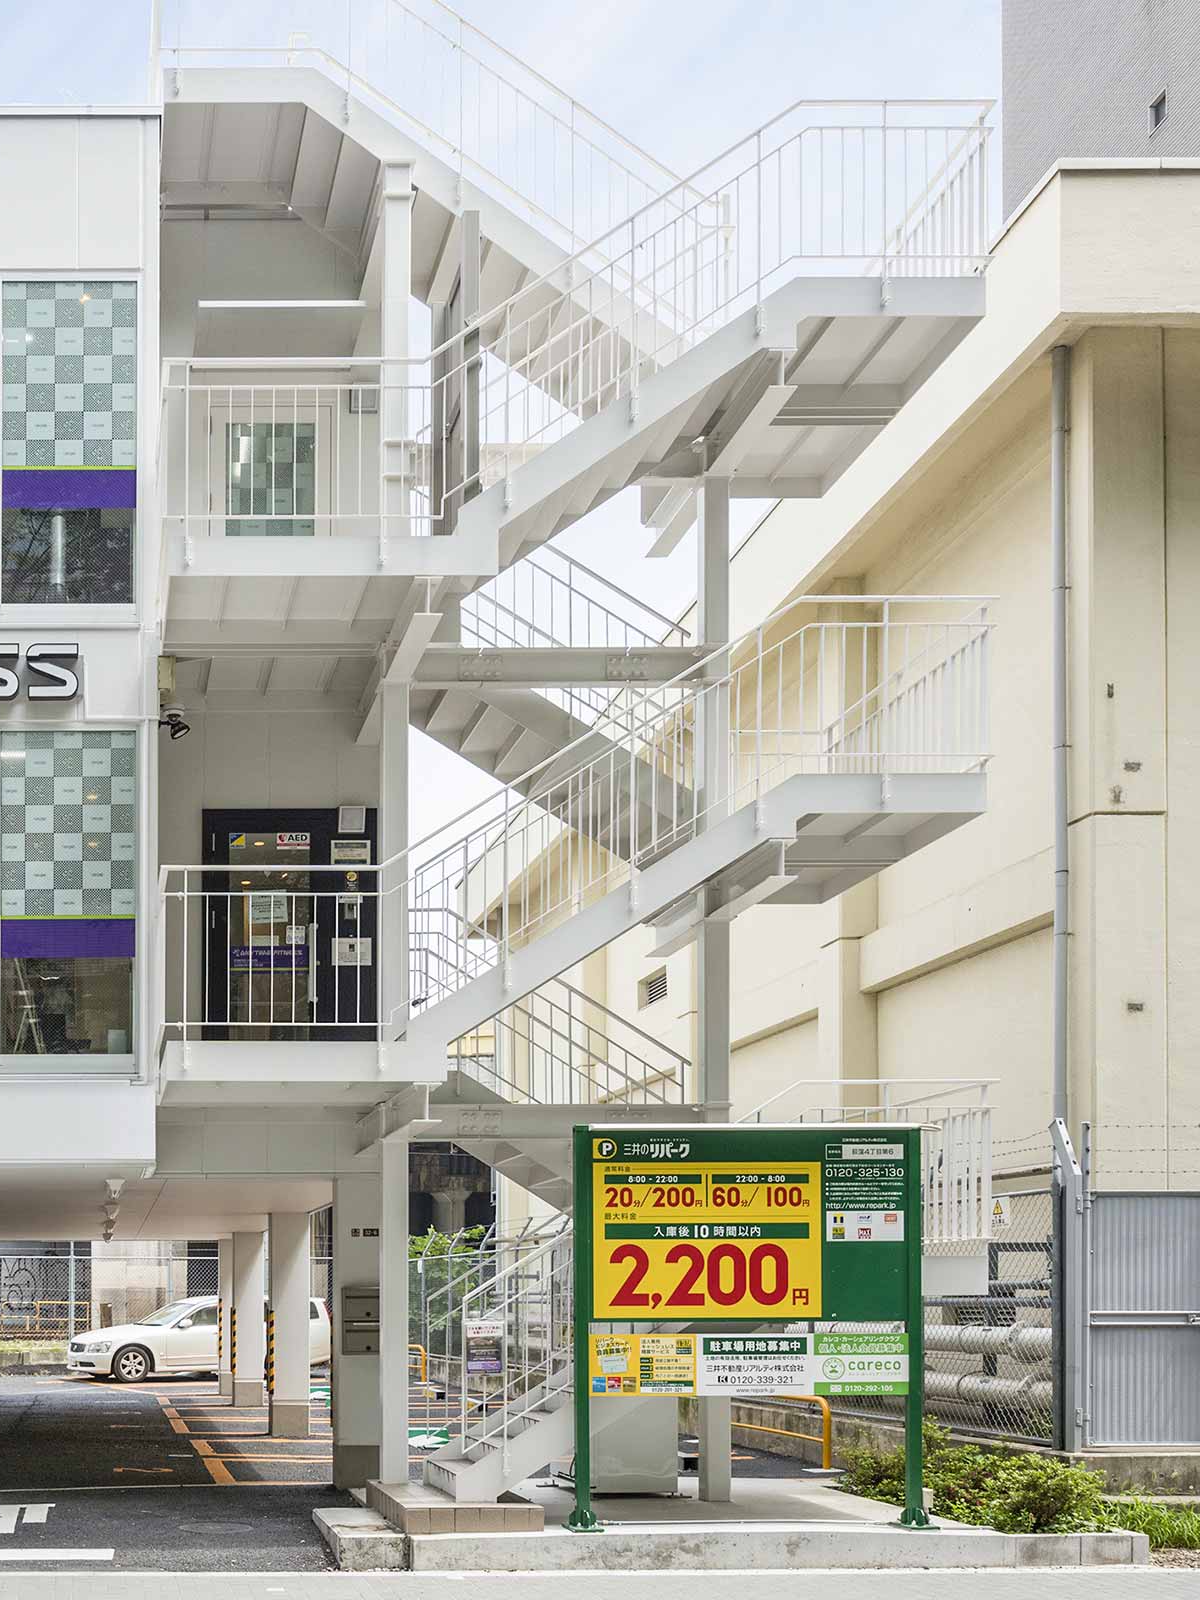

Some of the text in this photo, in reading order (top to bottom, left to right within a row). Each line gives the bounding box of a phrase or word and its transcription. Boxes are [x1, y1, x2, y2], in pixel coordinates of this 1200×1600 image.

[287, 834, 308, 842] AED
[623, 1142, 690, 1159] 三井のリパーク
[825, 1168, 904, 1178] 0120-325-130
[628, 1175, 646, 1184] 8:00
[655, 1175, 679, 1184] 22:00
[736, 1175, 759, 1184] 22:00
[768, 1175, 786, 1184] 8:00
[709, 1341, 801, 1352] 駐車場用地募集中
[848, 1360, 902, 1371] careco
[730, 1375, 794, 1384] 0120-339-321
